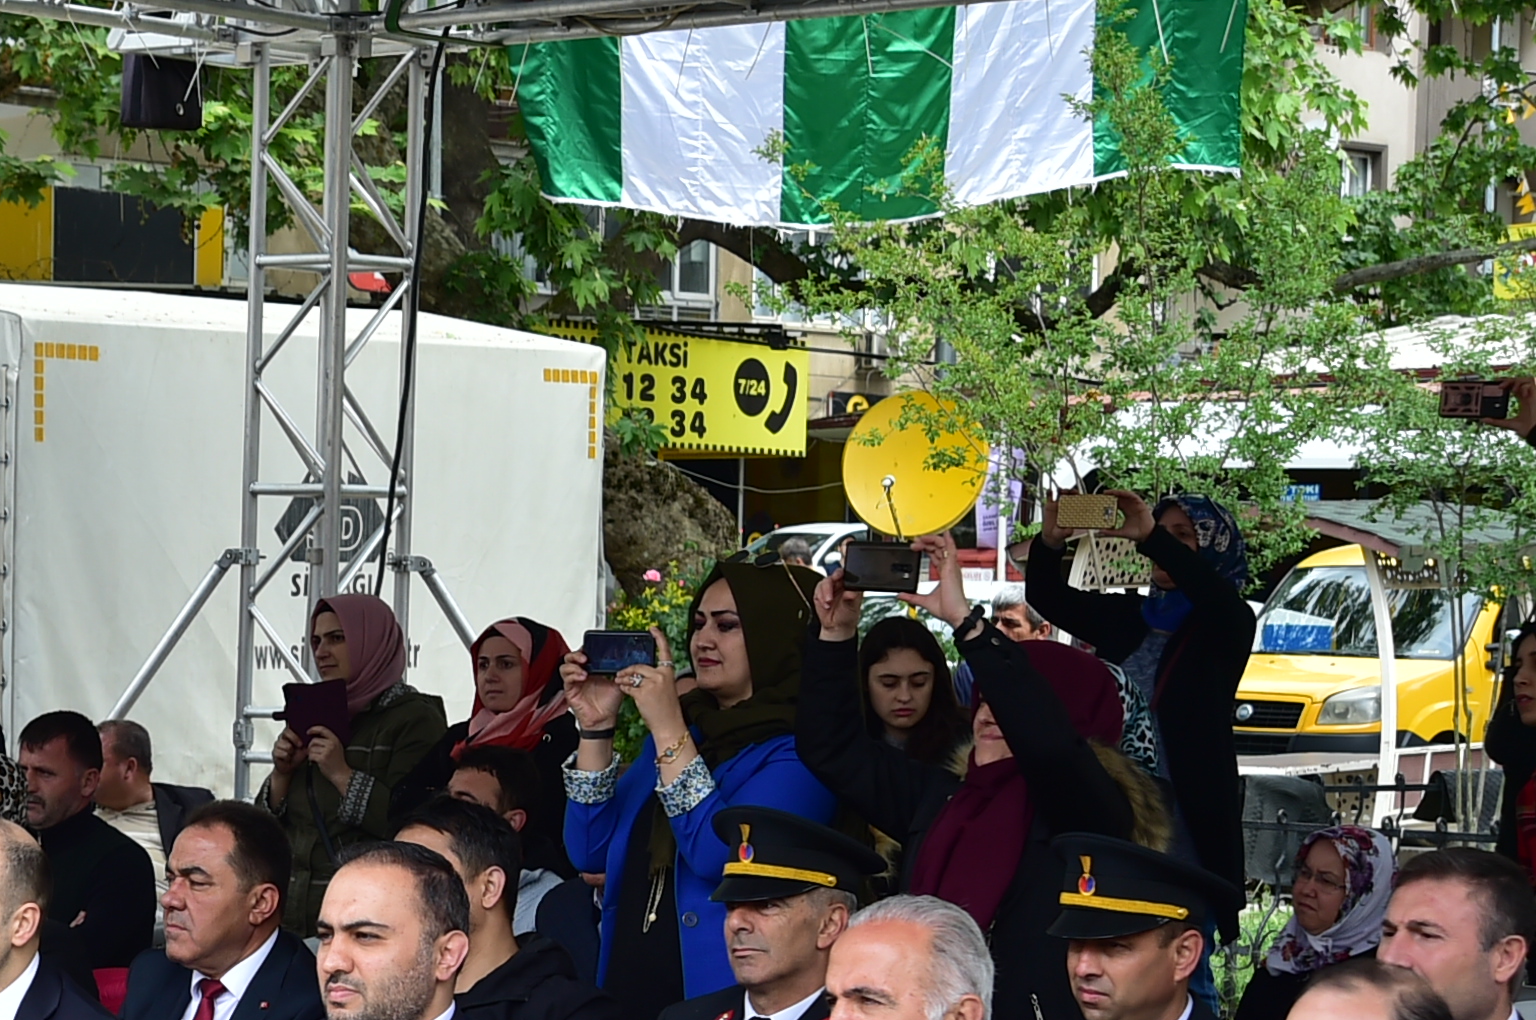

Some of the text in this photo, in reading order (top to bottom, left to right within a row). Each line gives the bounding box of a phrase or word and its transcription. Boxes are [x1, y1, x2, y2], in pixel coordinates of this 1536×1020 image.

[622, 371, 708, 405] 12 34
[737, 378, 766, 396] 7/24
[670, 408, 707, 439] 34
